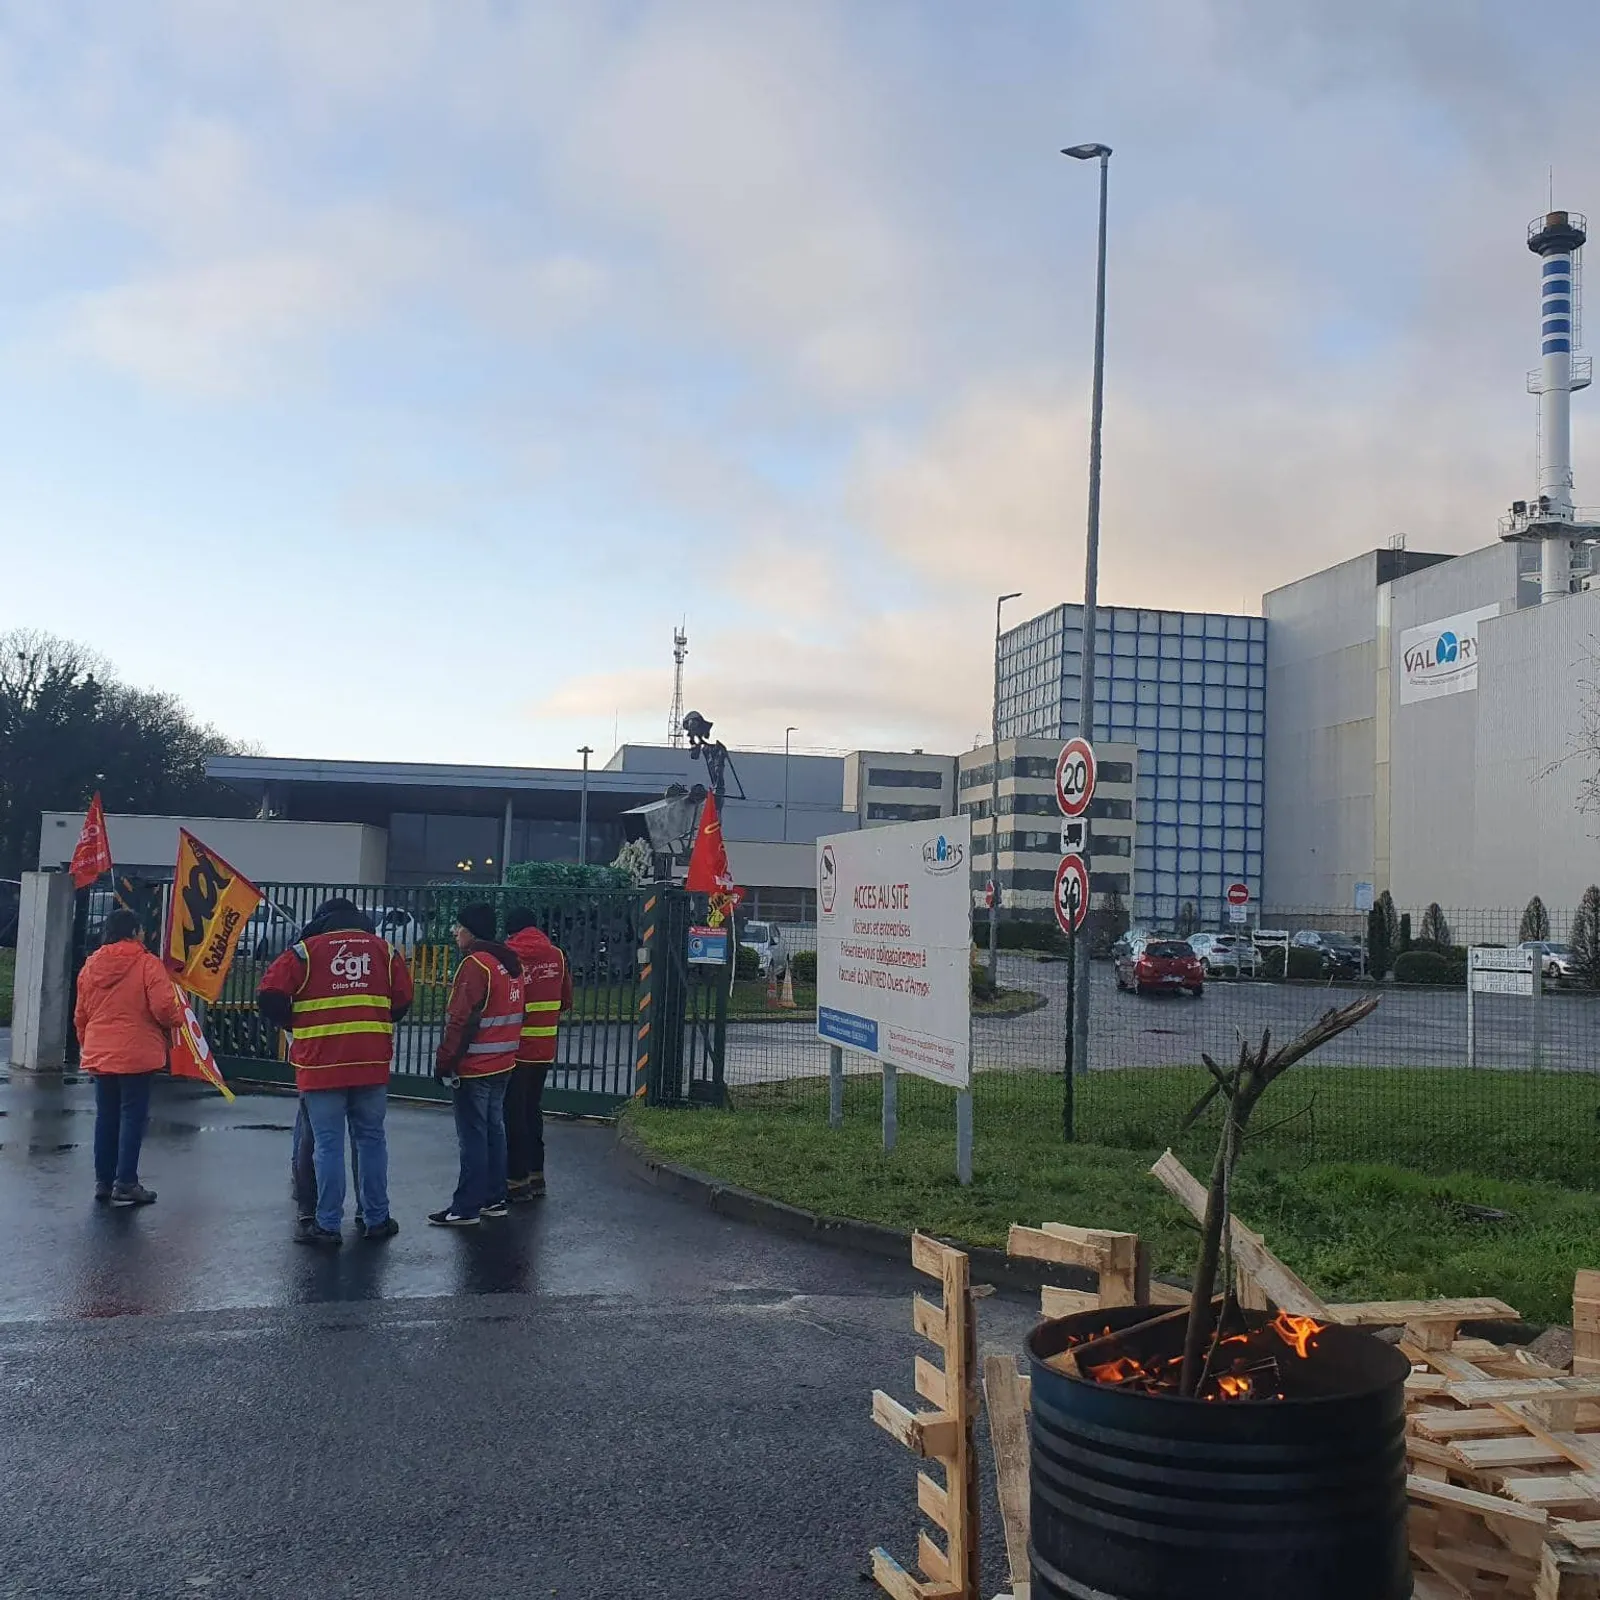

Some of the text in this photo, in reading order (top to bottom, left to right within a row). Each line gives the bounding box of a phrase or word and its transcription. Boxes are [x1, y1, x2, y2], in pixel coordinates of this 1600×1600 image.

[1064, 761, 1087, 795] 20
[853, 885, 876, 909] ACCES
[877, 884, 890, 909] AU
[891, 883, 909, 909] SITE
[1060, 876, 1080, 909] 30
[203, 910, 241, 974] Solidaires
[330, 953, 371, 980] cgt
